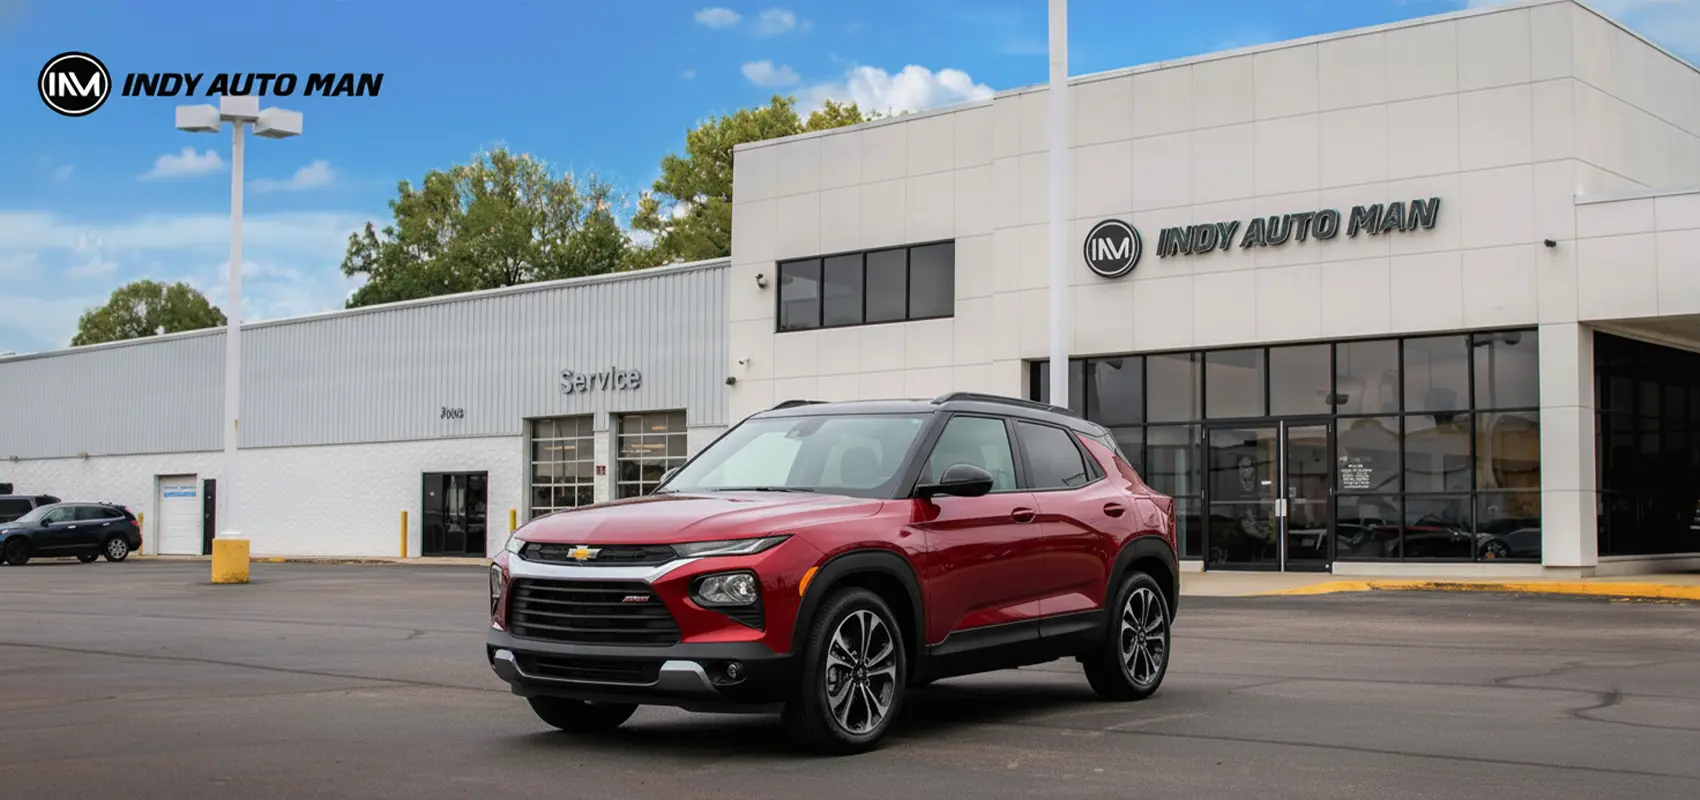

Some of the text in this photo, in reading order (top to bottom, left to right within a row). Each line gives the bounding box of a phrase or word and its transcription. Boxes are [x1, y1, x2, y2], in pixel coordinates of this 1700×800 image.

[1156, 197, 1441, 258] INDY AUTO MAN
[559, 366, 642, 396] Service
